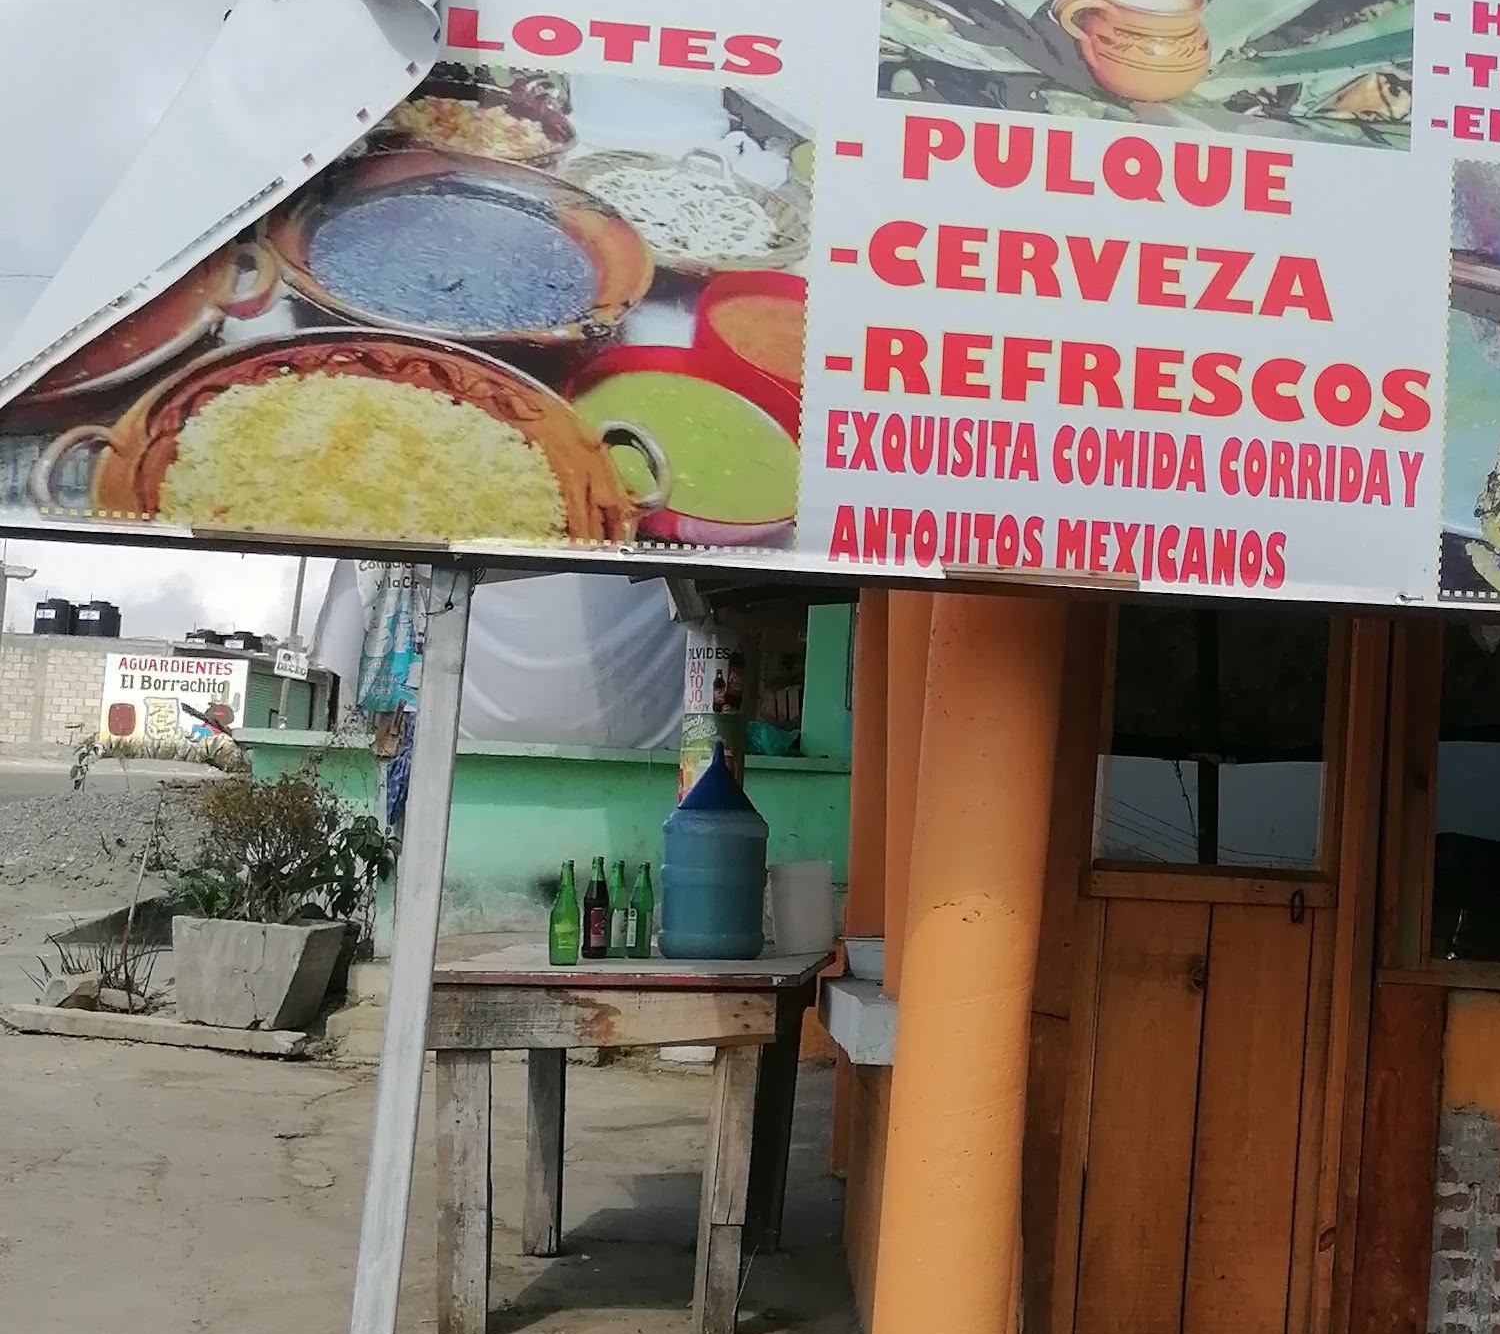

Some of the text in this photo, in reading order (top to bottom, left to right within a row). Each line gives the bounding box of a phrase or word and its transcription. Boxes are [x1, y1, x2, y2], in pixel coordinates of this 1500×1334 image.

[446, 6, 784, 77] LOTES
[901, 114, 1295, 216] PULQUE
[825, 409, 1040, 483] EXQUISITA
[1051, 423, 1207, 494] COMIDA
[828, 504, 1288, 590] ANTOJITOS MEXICANOS
[118, 656, 234, 676] AGUARDIENTES
[120, 673, 226, 694] El Borrachito
